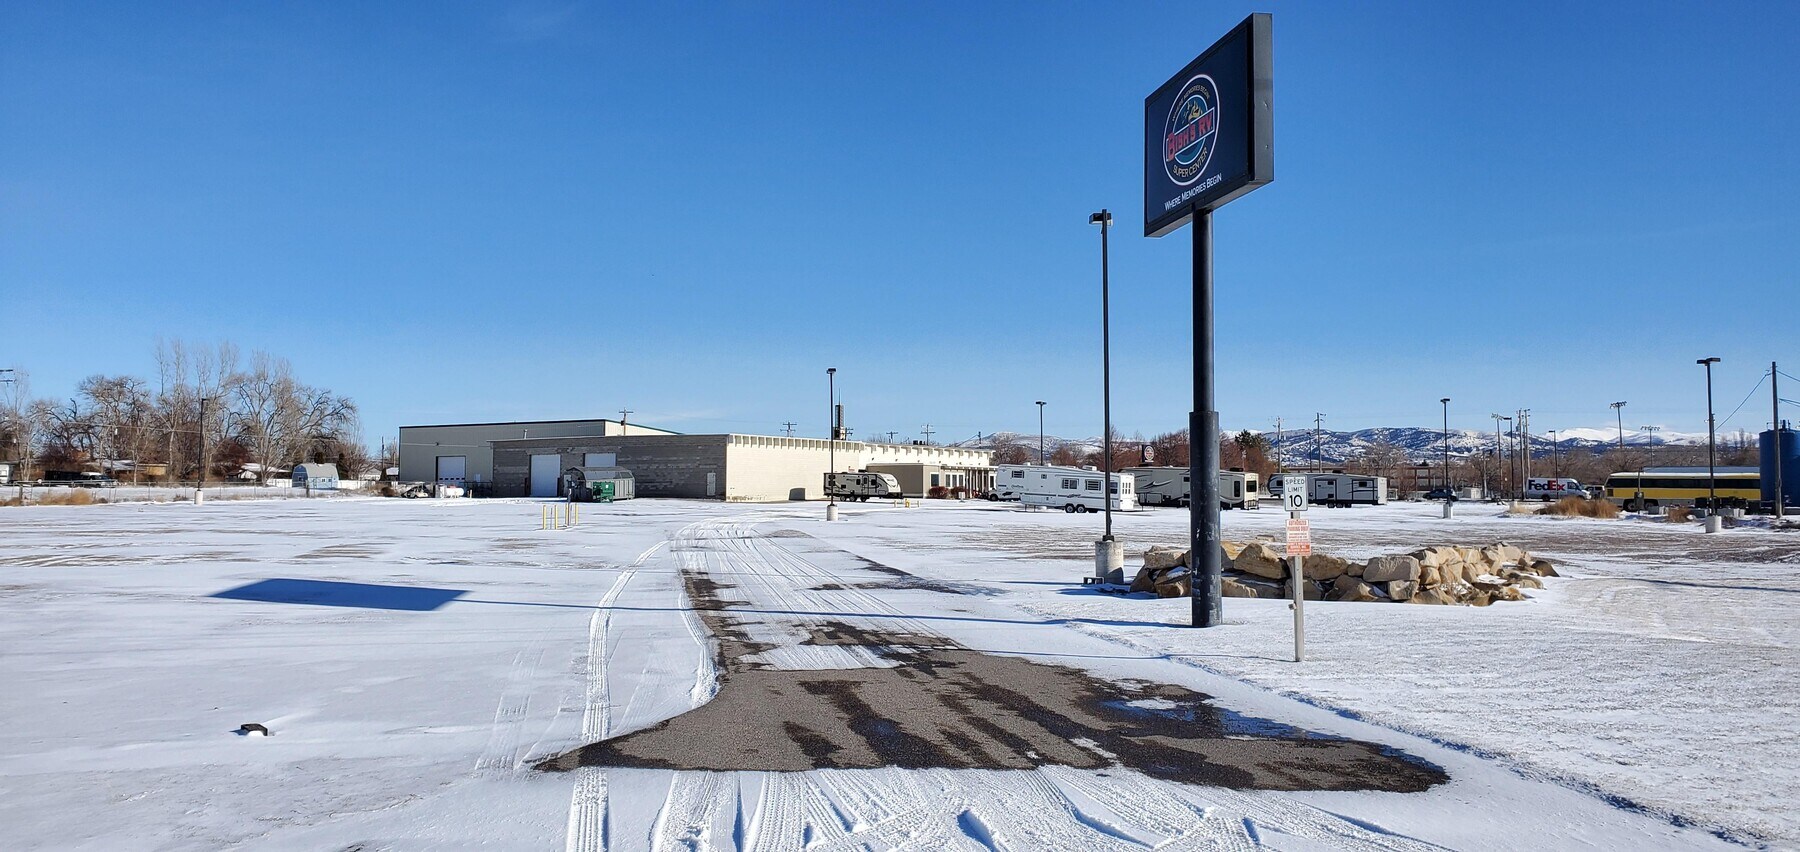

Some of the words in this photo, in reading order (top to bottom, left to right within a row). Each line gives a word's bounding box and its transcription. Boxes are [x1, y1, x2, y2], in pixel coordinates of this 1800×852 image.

[1198, 113, 1212, 136] RV
[1172, 164, 1189, 178] SUPER
[1188, 147, 1208, 176] CENTER
[1164, 194, 1182, 211] WHERE
[1182, 183, 1207, 202] MEMORIES
[1206, 173, 1222, 190] BEGIN
[1528, 479, 1566, 491] FedEx
[1289, 494, 1303, 507] 10
